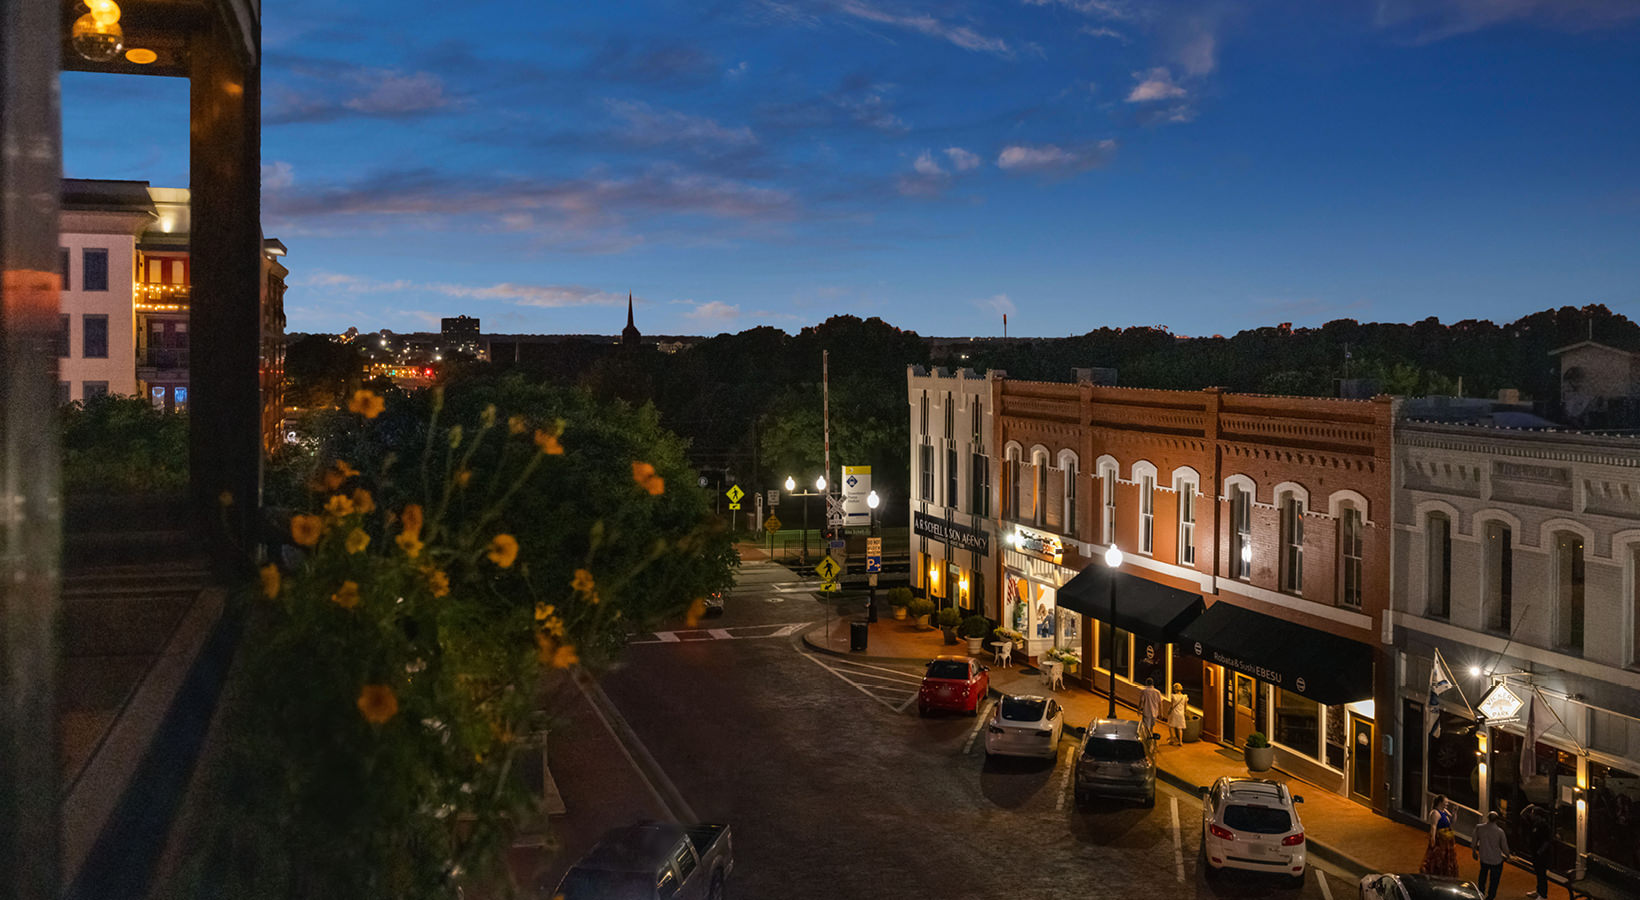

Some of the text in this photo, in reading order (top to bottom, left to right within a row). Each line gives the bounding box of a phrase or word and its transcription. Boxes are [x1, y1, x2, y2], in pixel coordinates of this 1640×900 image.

[914, 518, 920, 529] A
[924, 520, 944, 536] SCHELL
[949, 527, 961, 542] SON
[961, 533, 987, 549] AGENCY
[867, 558, 875, 570] P
[1255, 665, 1282, 683] EBESU
